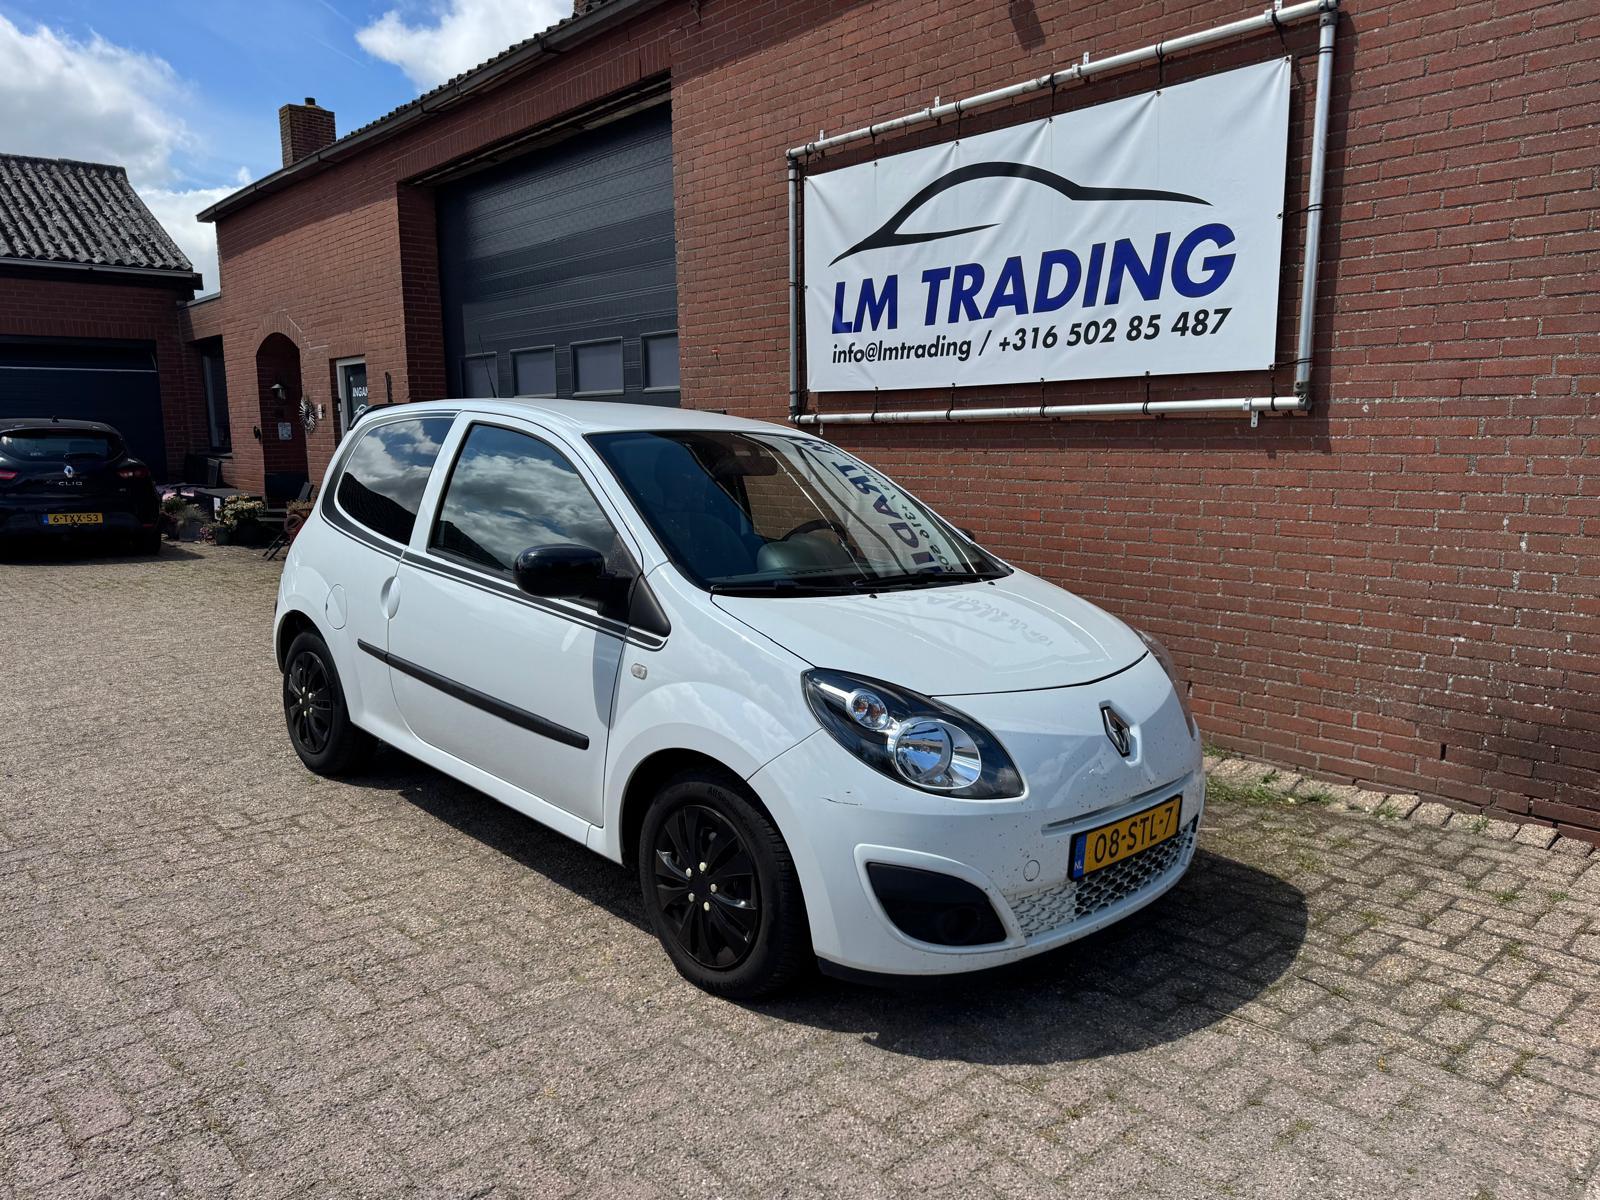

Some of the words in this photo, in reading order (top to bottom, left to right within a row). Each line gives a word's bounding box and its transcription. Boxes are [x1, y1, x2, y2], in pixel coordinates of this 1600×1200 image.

[832, 274, 898, 334] LM
[921, 223, 1237, 326] TRADING
[832, 334, 972, 364] info@lmtrading
[978, 329, 993, 357] /
[999, 325, 1058, 352] +316
[1066, 318, 1117, 347] 502
[1126, 314, 1161, 341] 85
[1171, 307, 1233, 337] 487
[53, 514, 99, 524] 6-TXX-53
[1074, 860, 1083, 870] NL
[1094, 806, 1174, 863] 08-STL-7
